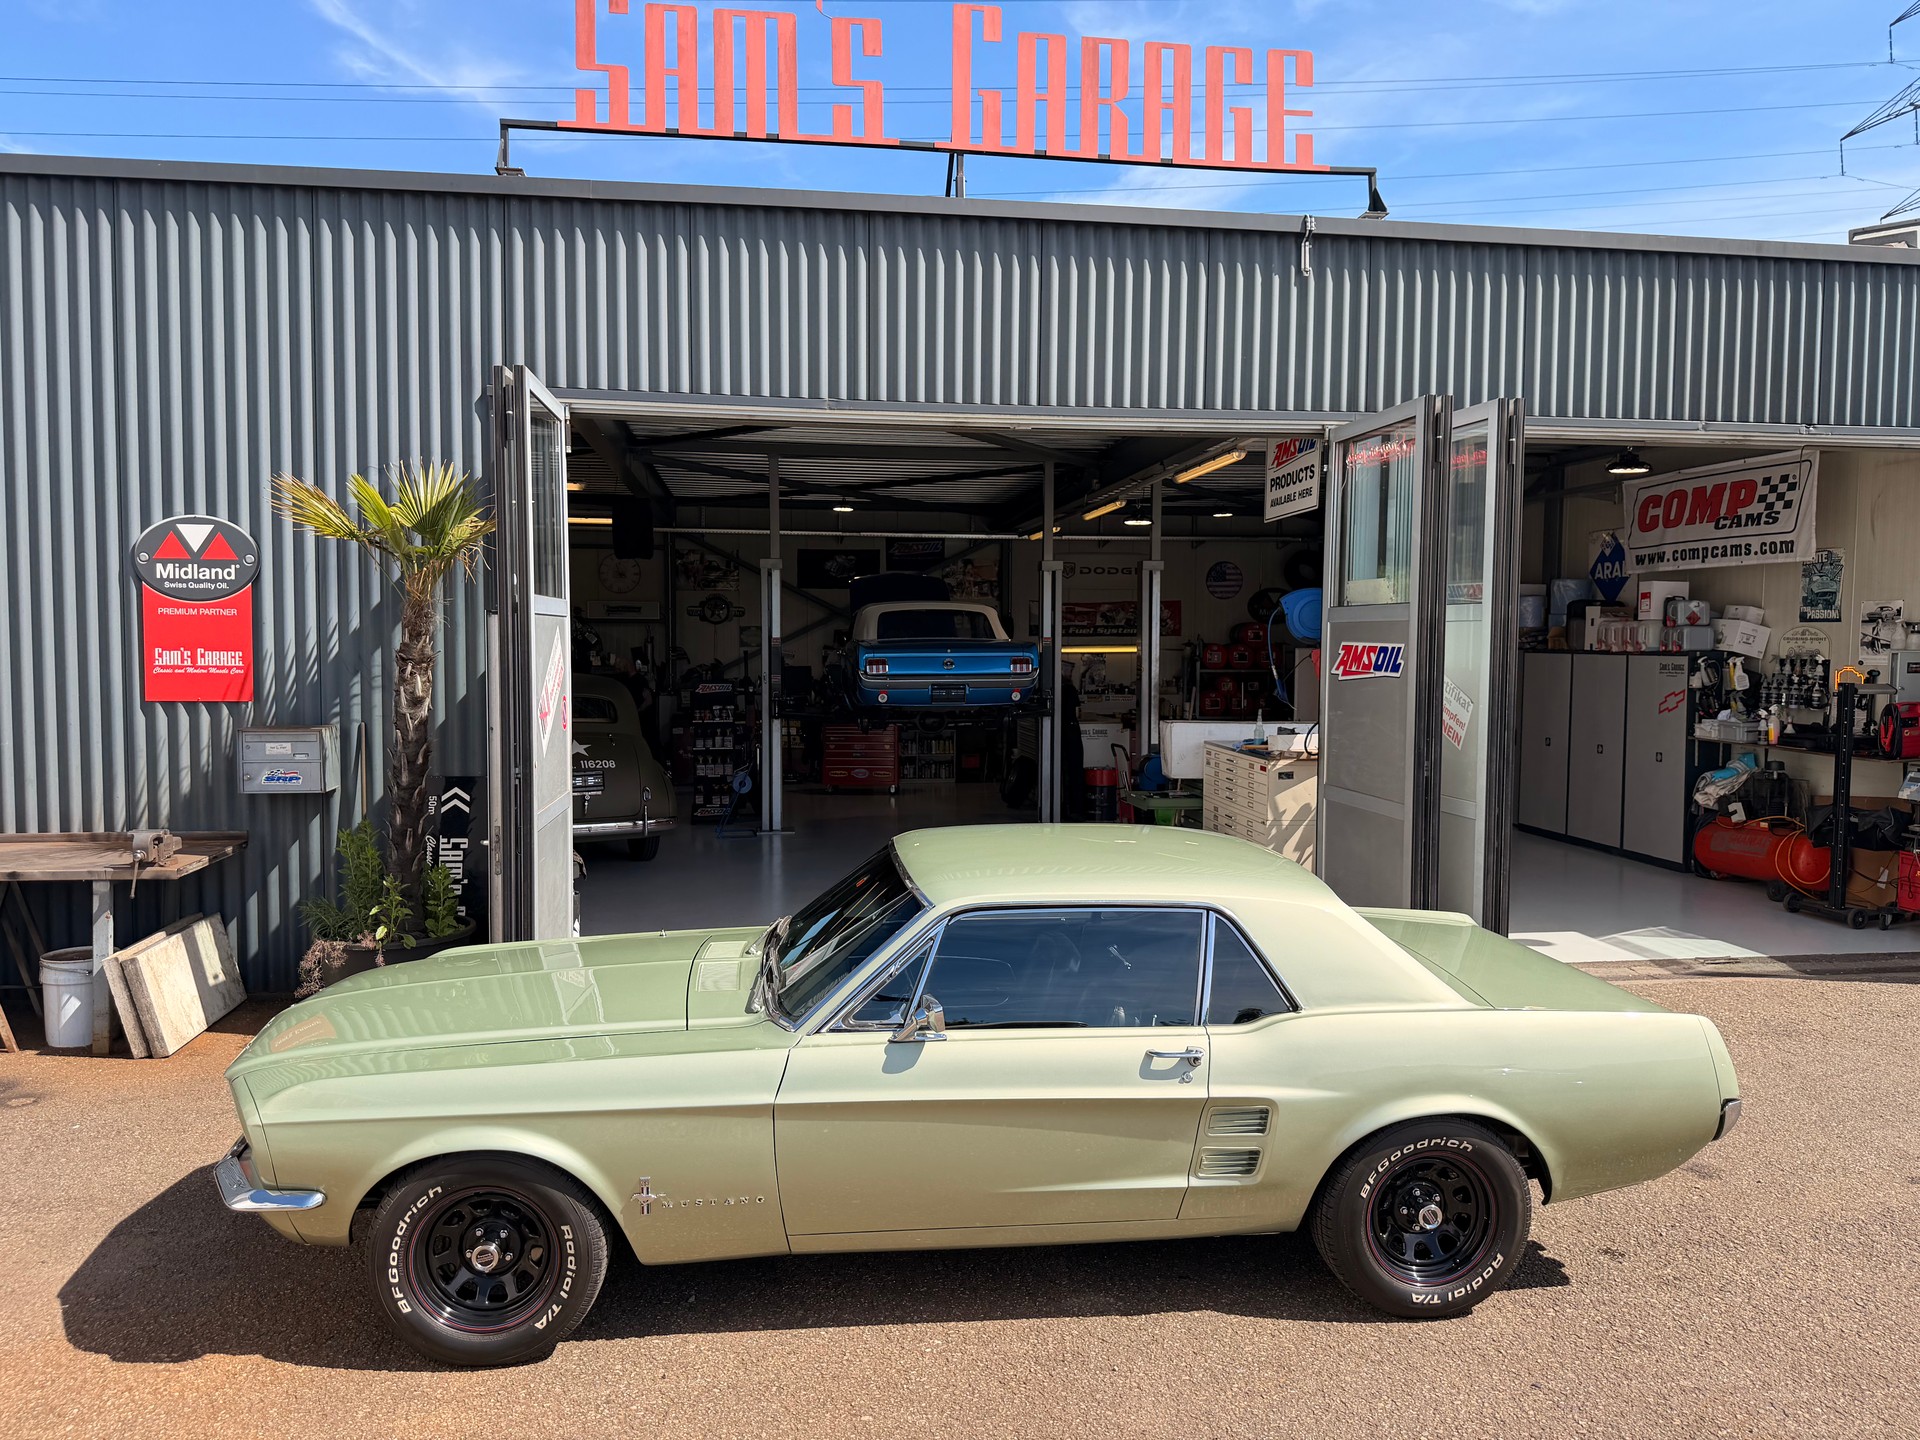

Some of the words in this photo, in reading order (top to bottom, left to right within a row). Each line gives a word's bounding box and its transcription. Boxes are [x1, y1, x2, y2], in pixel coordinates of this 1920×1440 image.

[934, 3, 1330, 172] GARAGE
[1270, 464, 1315, 492] PRODUCTS
[1270, 491, 1297, 508] AVAILABLE
[1297, 486, 1313, 500] HERE
[1637, 479, 1757, 533] COMP
[1714, 510, 1780, 530] CAMS
[1635, 540, 1795, 566] www.compcams.com
[156, 563, 237, 581] Midland
[1079, 567, 1138, 575] DODG
[1594, 561, 1630, 580] ARAL
[164, 581, 187, 589] Swiss
[188, 582, 215, 590] Quality
[158, 608, 198, 616] PREMIUM
[200, 608, 238, 616] PARTNER
[1806, 608, 1840, 620] PASSION!
[1069, 626, 1094, 635] Fuel
[196, 647, 244, 667] GARAGE
[1335, 645, 1403, 677] AMSOIL
[153, 666, 173, 674] Classic
[230, 667, 244, 675] Cars
[696, 683, 733, 694] AMSOIL
[1443, 680, 1472, 713] tifikat
[1442, 718, 1462, 747] NEIN
[580, 759, 616, 769] 116208
[263, 774, 302, 783] SRP
[427, 795, 438, 815] 50m
[1359, 1136, 1474, 1199] BFGoodrich
[661, 1195, 765, 1208] MUSTANG
[388, 1185, 443, 1314] BFGoodrich
[560, 1224, 578, 1300] Radial
[1447, 1252, 1505, 1302] Radial
[1411, 1292, 1442, 1305] T/A
[534, 1303, 563, 1330] T/A
